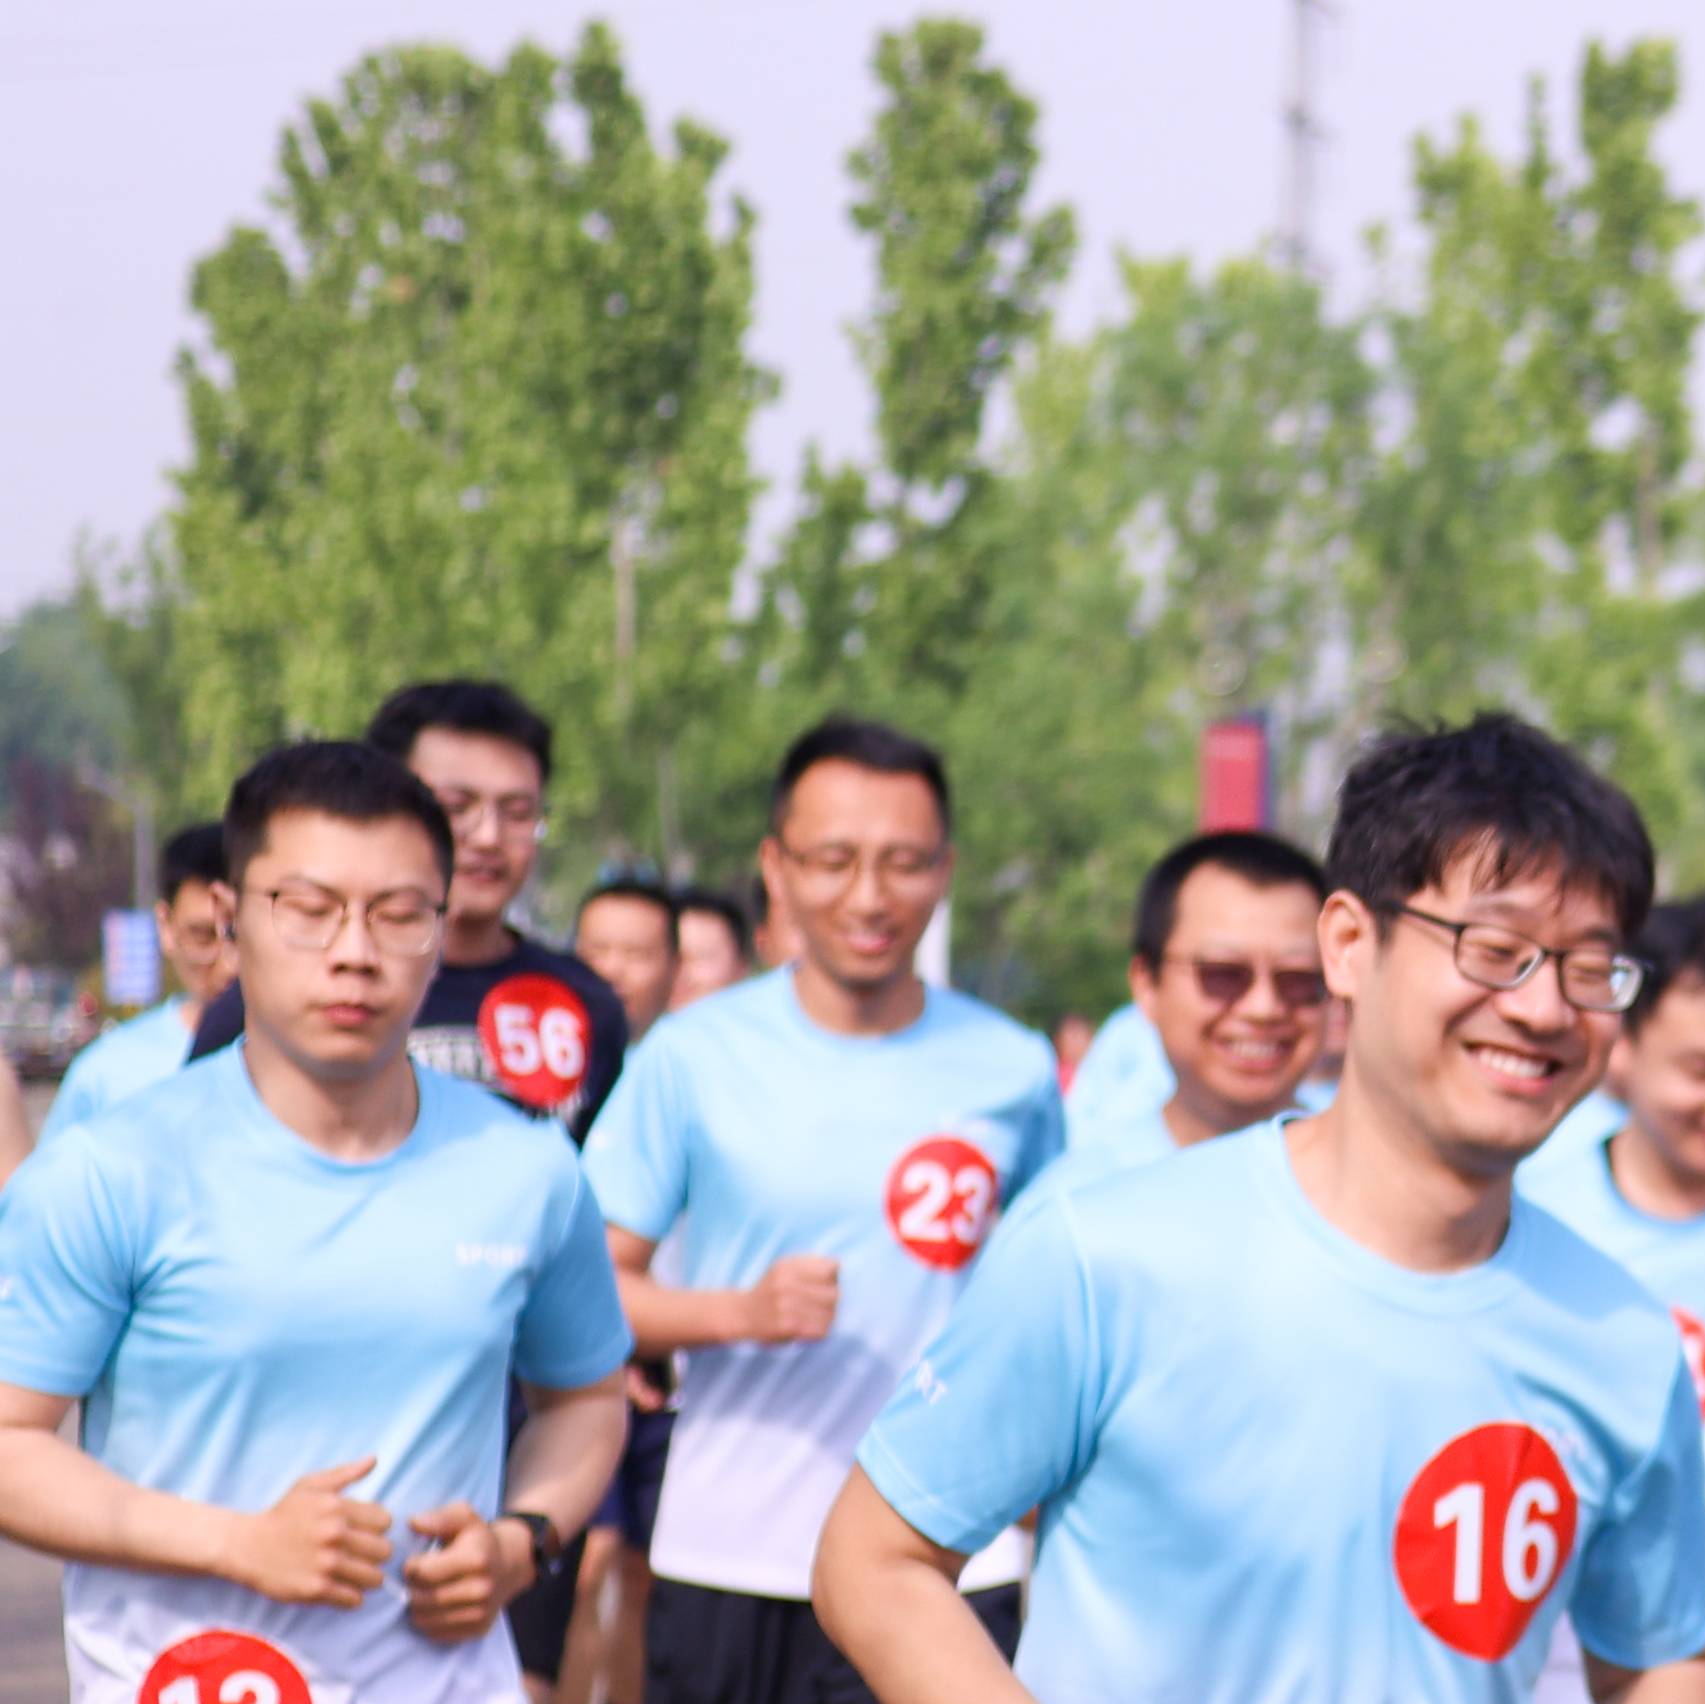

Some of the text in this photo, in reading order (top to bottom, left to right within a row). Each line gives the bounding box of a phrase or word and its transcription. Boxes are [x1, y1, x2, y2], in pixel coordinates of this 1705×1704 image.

[493, 1002, 585, 1080] 56
[900, 1160, 992, 1245] 23
[1433, 1478, 1560, 1604] 16
